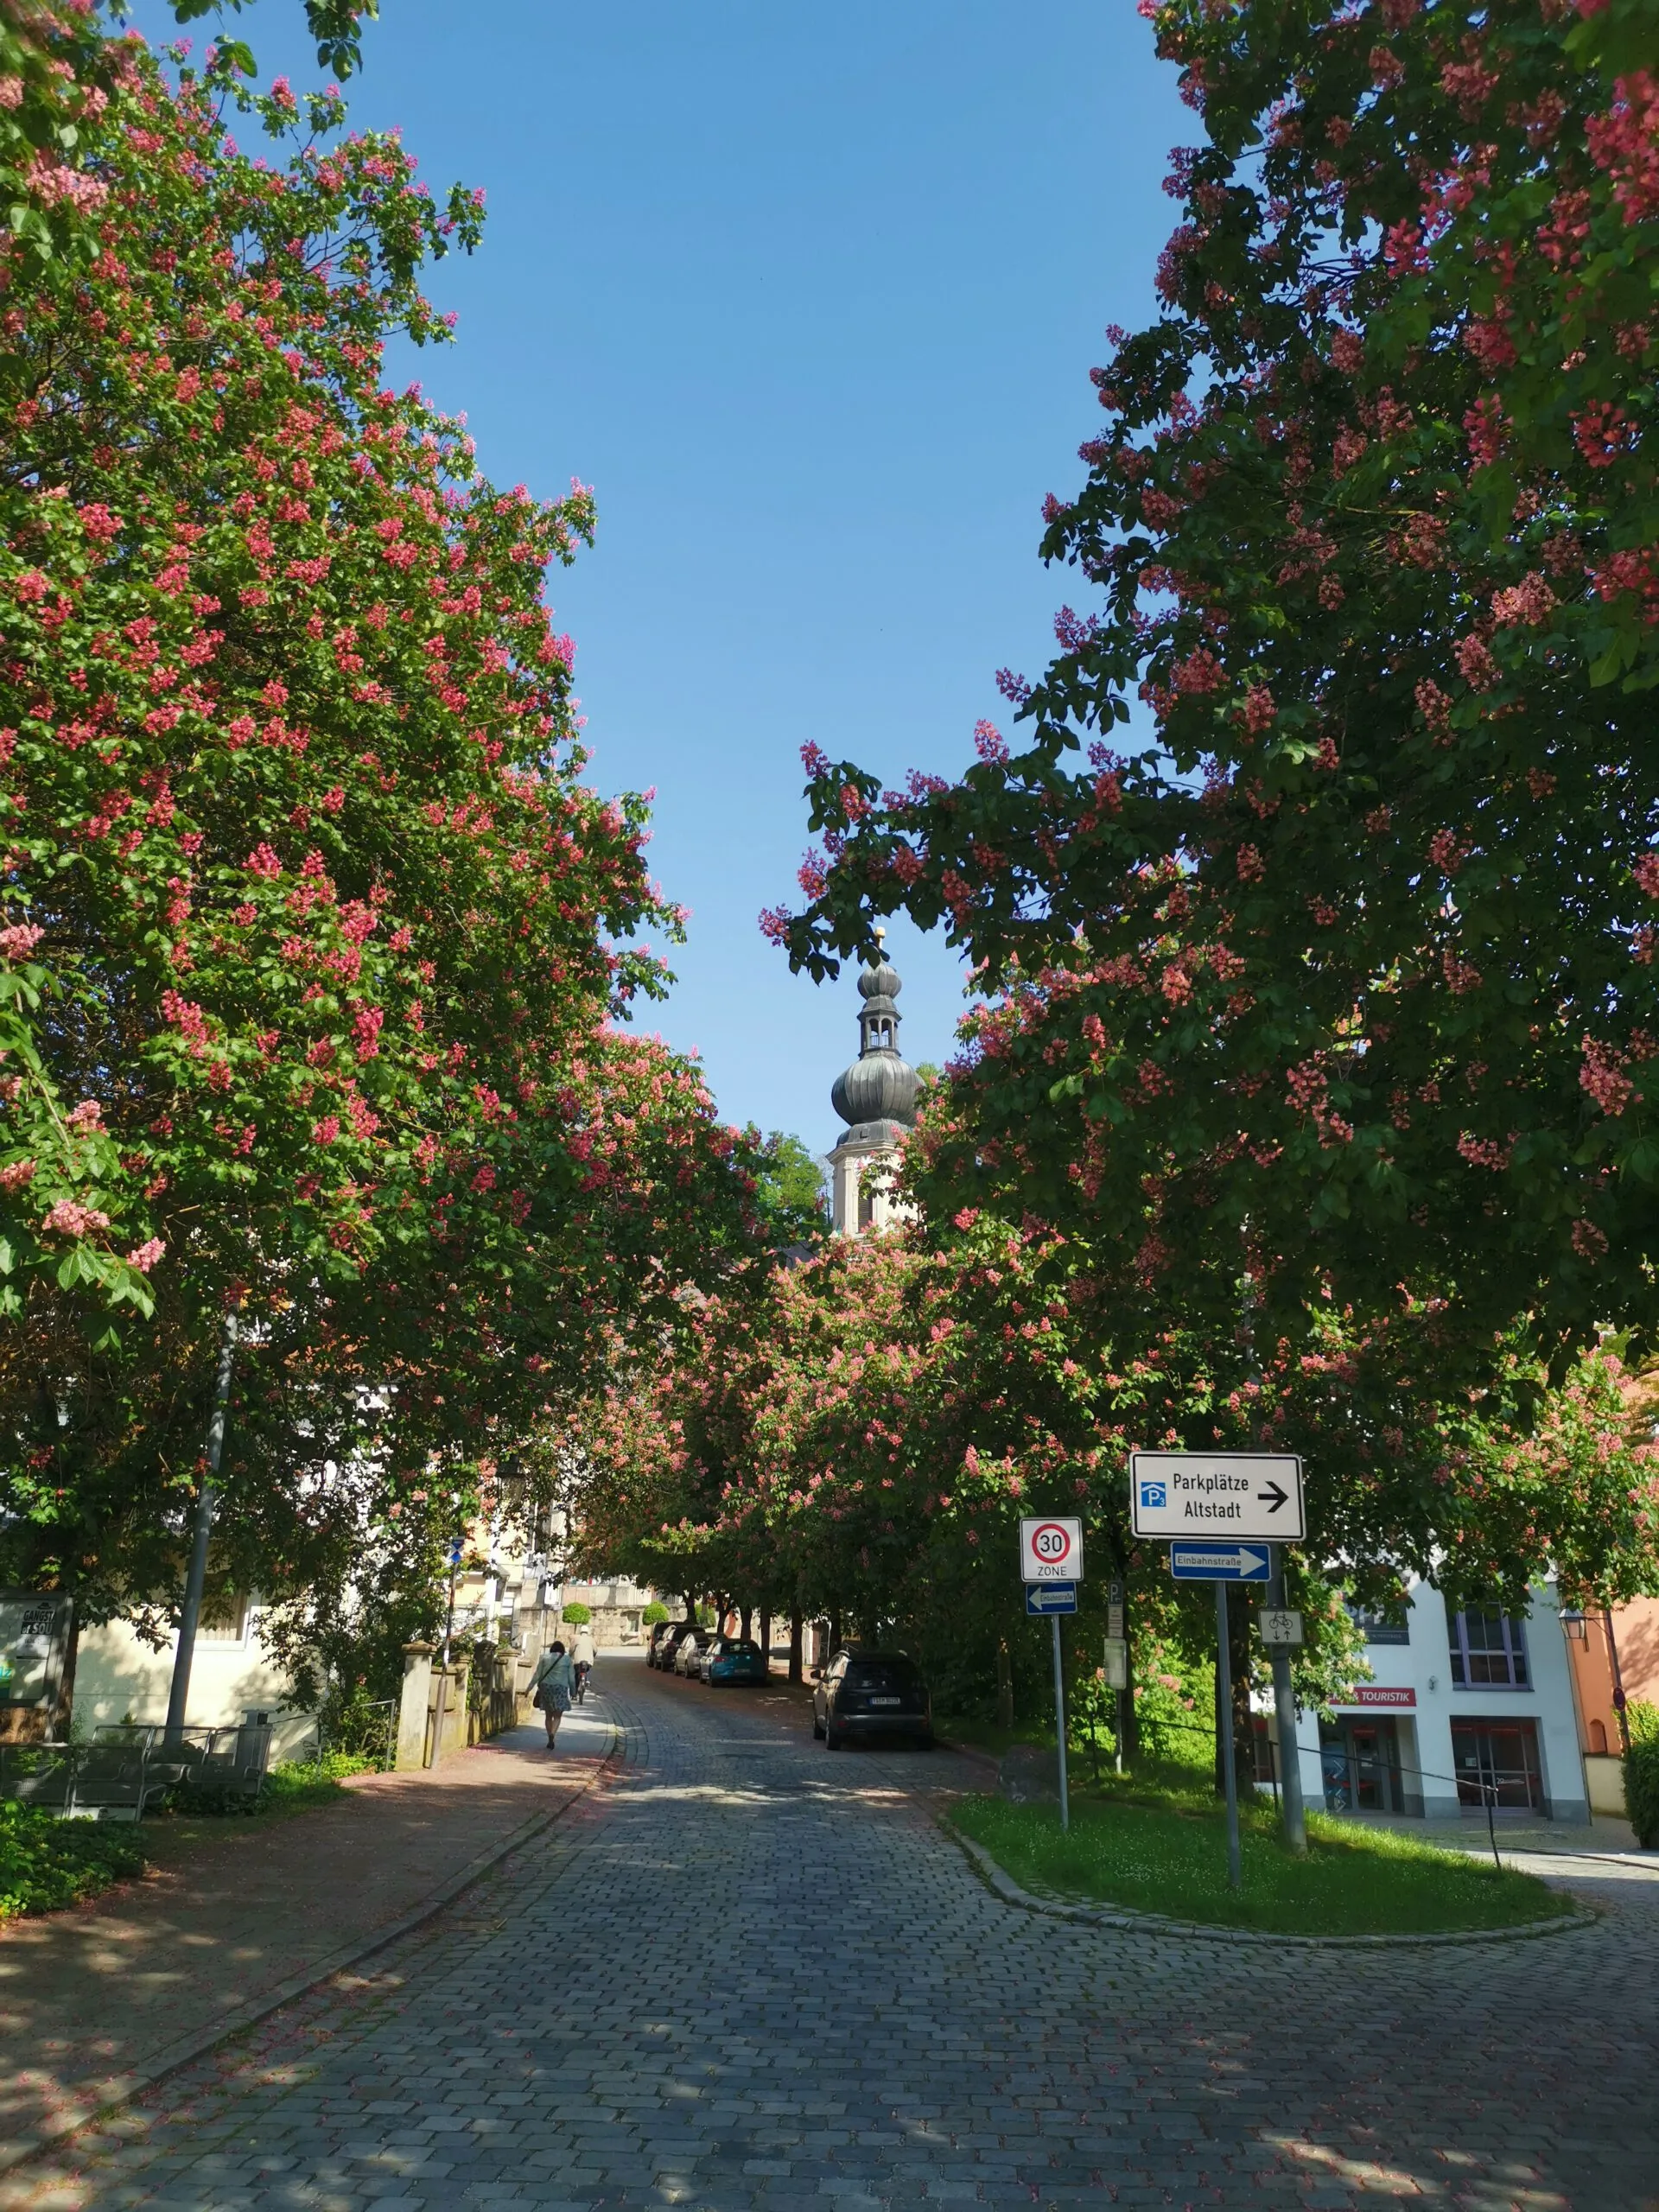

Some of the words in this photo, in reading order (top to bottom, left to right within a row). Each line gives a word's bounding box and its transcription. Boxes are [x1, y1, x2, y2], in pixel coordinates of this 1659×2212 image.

[1173, 1473, 1249, 1494] Parkplätze
[1185, 1501, 1241, 1518] Altstadt
[1039, 1535, 1062, 1552] 30
[1177, 1556, 1242, 1566] Einbahnstraße
[1038, 1567, 1067, 1576] ZONE
[22, 1624, 31, 1634] of
[1362, 1692, 1409, 1702] TOURISTIK
